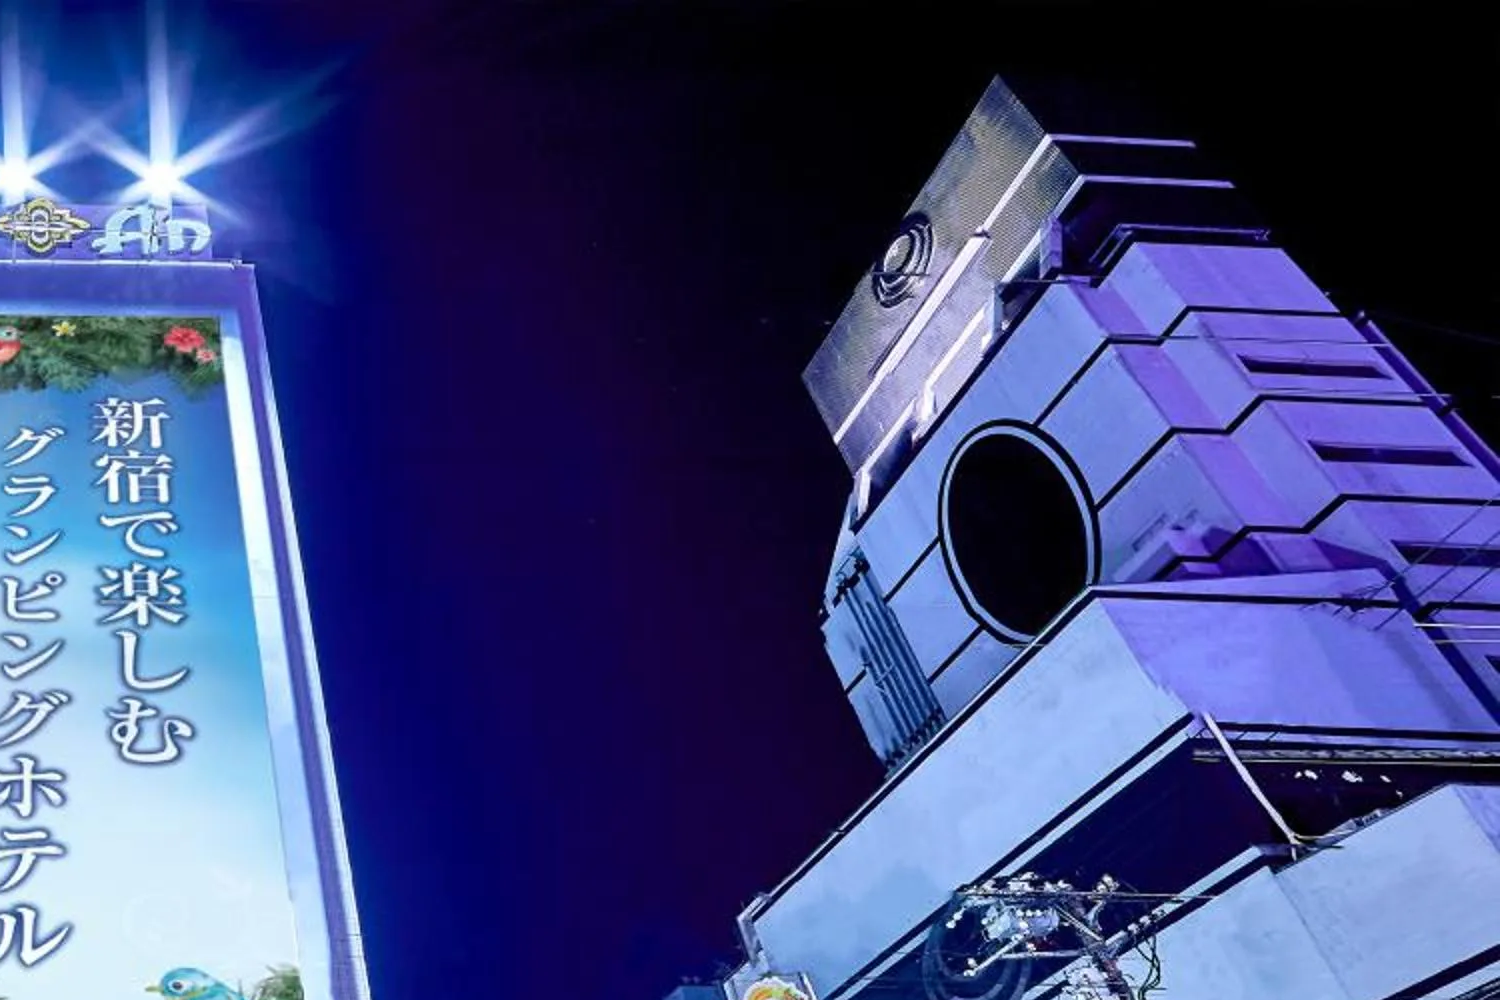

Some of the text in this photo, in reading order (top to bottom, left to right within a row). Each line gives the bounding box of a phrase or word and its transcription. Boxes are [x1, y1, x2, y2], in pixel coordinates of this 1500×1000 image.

[90, 203, 213, 256] An
[92, 397, 195, 765] 新宿で楽しむ
